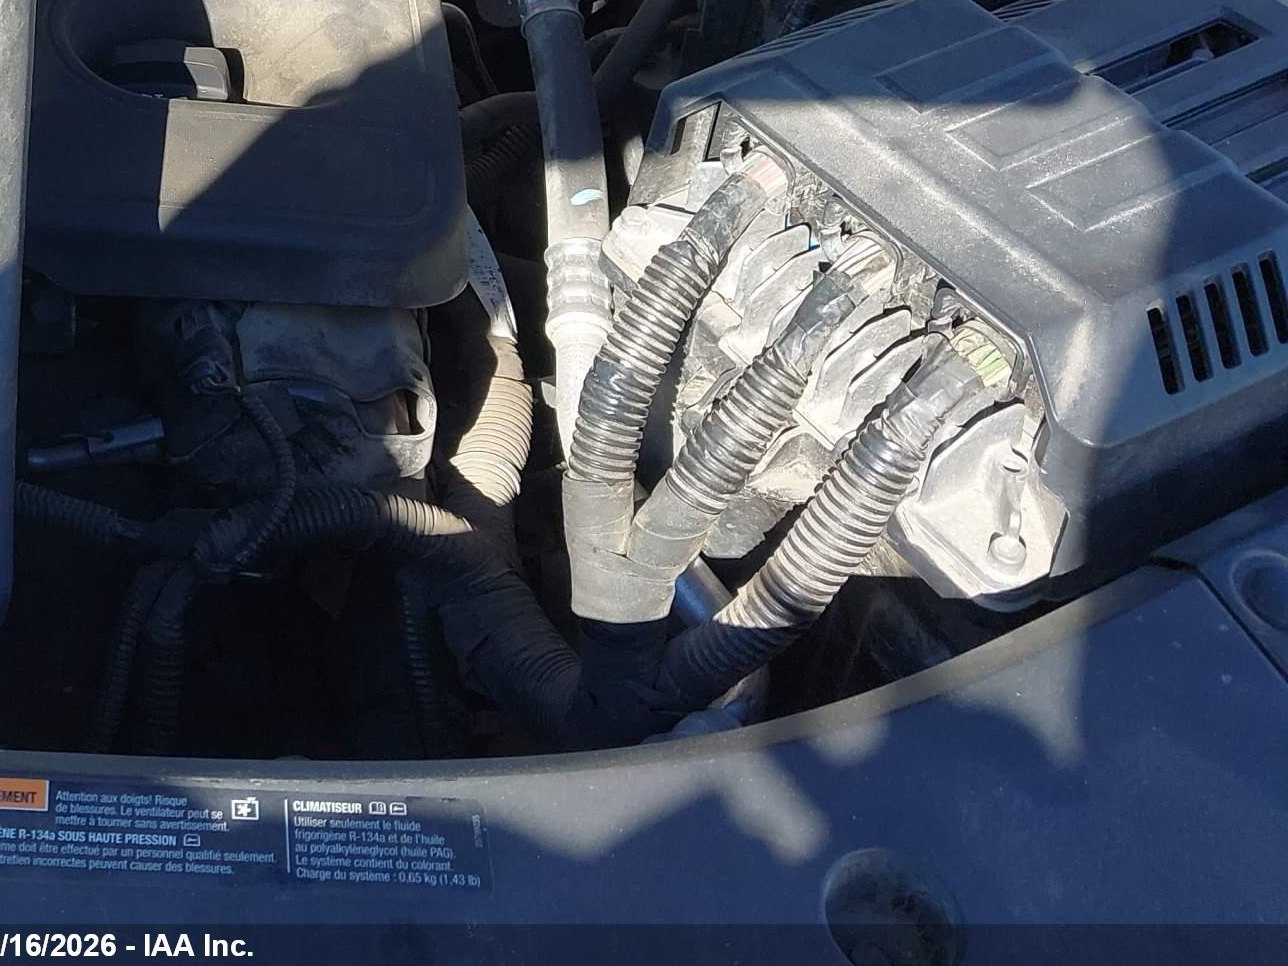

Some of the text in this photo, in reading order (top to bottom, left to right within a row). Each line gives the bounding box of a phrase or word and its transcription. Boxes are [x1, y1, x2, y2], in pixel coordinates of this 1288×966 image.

[56, 791, 187, 807] Attention aux doigts! Risque
[293, 800, 362, 814] CLIMATISEUR
[56, 803, 67, 813] de
[120, 805, 132, 816] Le
[134, 806, 185, 818] ventilateur
[187, 808, 210, 820] peut
[211, 810, 223, 819] se
[56, 816, 86, 826] mettre
[98, 817, 132, 828] tourner
[135, 820, 157, 829] sans
[159, 819, 230, 832] avertissement.
[294, 816, 421, 832] Utiliser seulement le fluide
[18, 829, 55, 841] R-134a
[58, 830, 86, 843] SOUS
[88, 832, 123, 844] HAUTE
[125, 833, 177, 846] PRESSION
[295, 829, 445, 845] frigorigène R-134a et de l'huile
[18, 841, 36, 852] doit
[103, 848, 118, 857] par
[121, 848, 133, 857] un
[136, 848, 183, 860] personnel
[295, 844, 307, 853] au
[401, 845, 428, 858] (huile
[430, 847, 457, 860] PAG).
[33, 857, 86, 869] incorrectes
[89, 859, 128, 871] peuvent
[130, 861, 162, 871] causer
[165, 861, 183, 872] des
[296, 855, 454, 872] Le système contient du colorant.
[296, 867, 332, 881] Charge
[334, 869, 346, 881] du
[349, 869, 390, 883] système
[424, 872, 437, 886] kg
[468, 874, 481, 888] lb)
